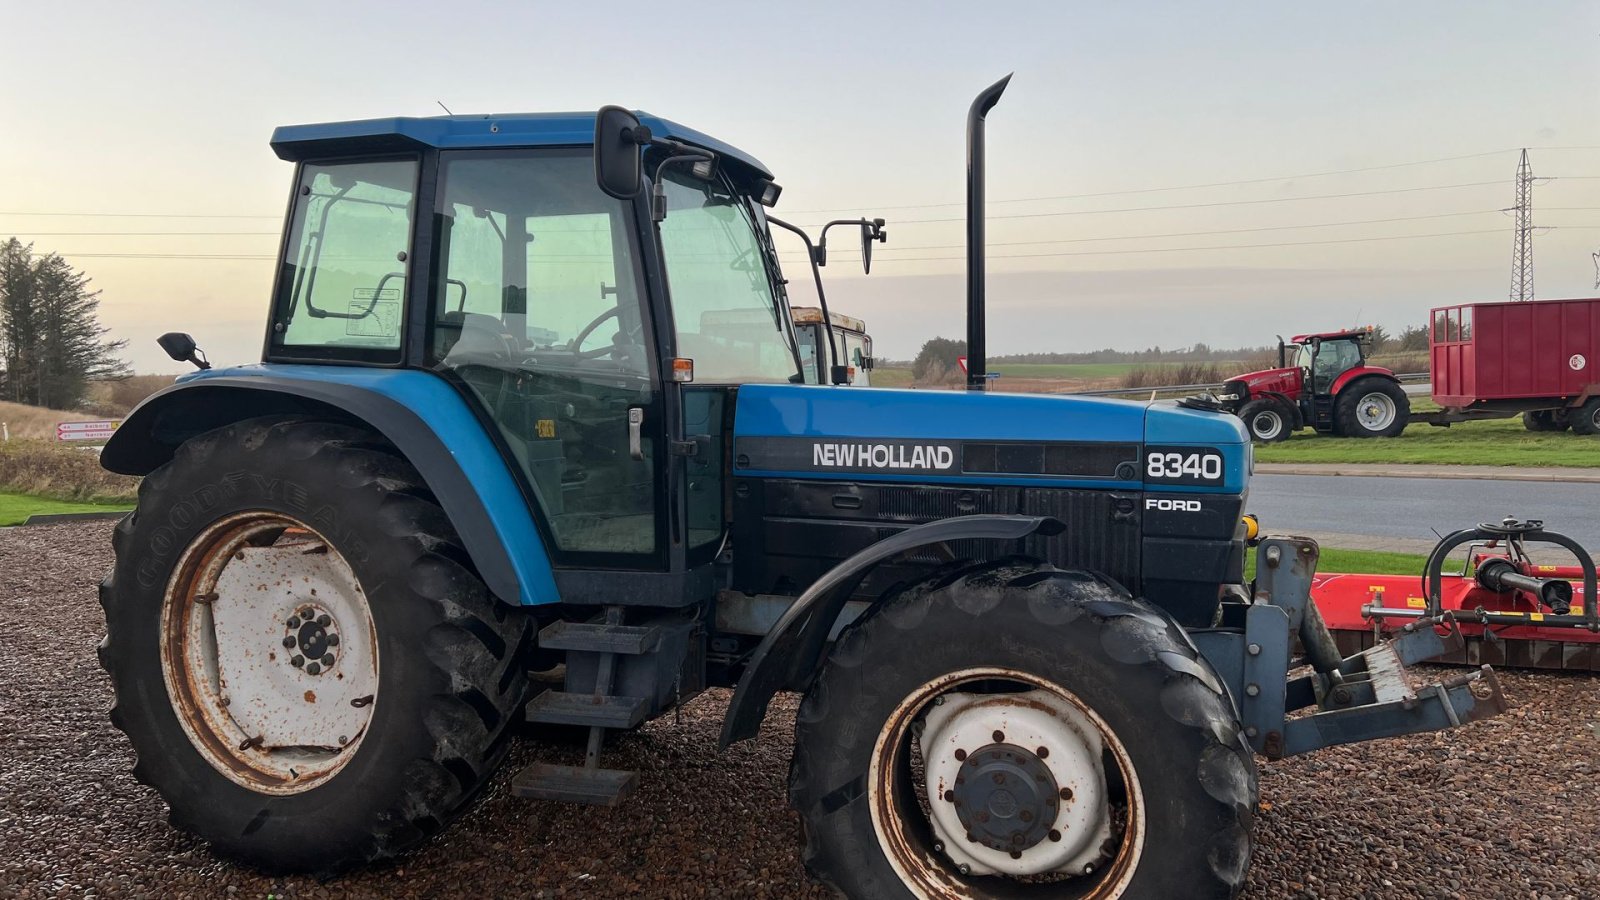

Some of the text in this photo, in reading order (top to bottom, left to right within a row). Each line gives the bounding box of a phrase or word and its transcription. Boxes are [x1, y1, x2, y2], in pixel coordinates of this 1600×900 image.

[813, 443, 954, 469] NEW HOLLAND
[1147, 452, 1222, 479] 8340
[1145, 499, 1202, 512] FORD
